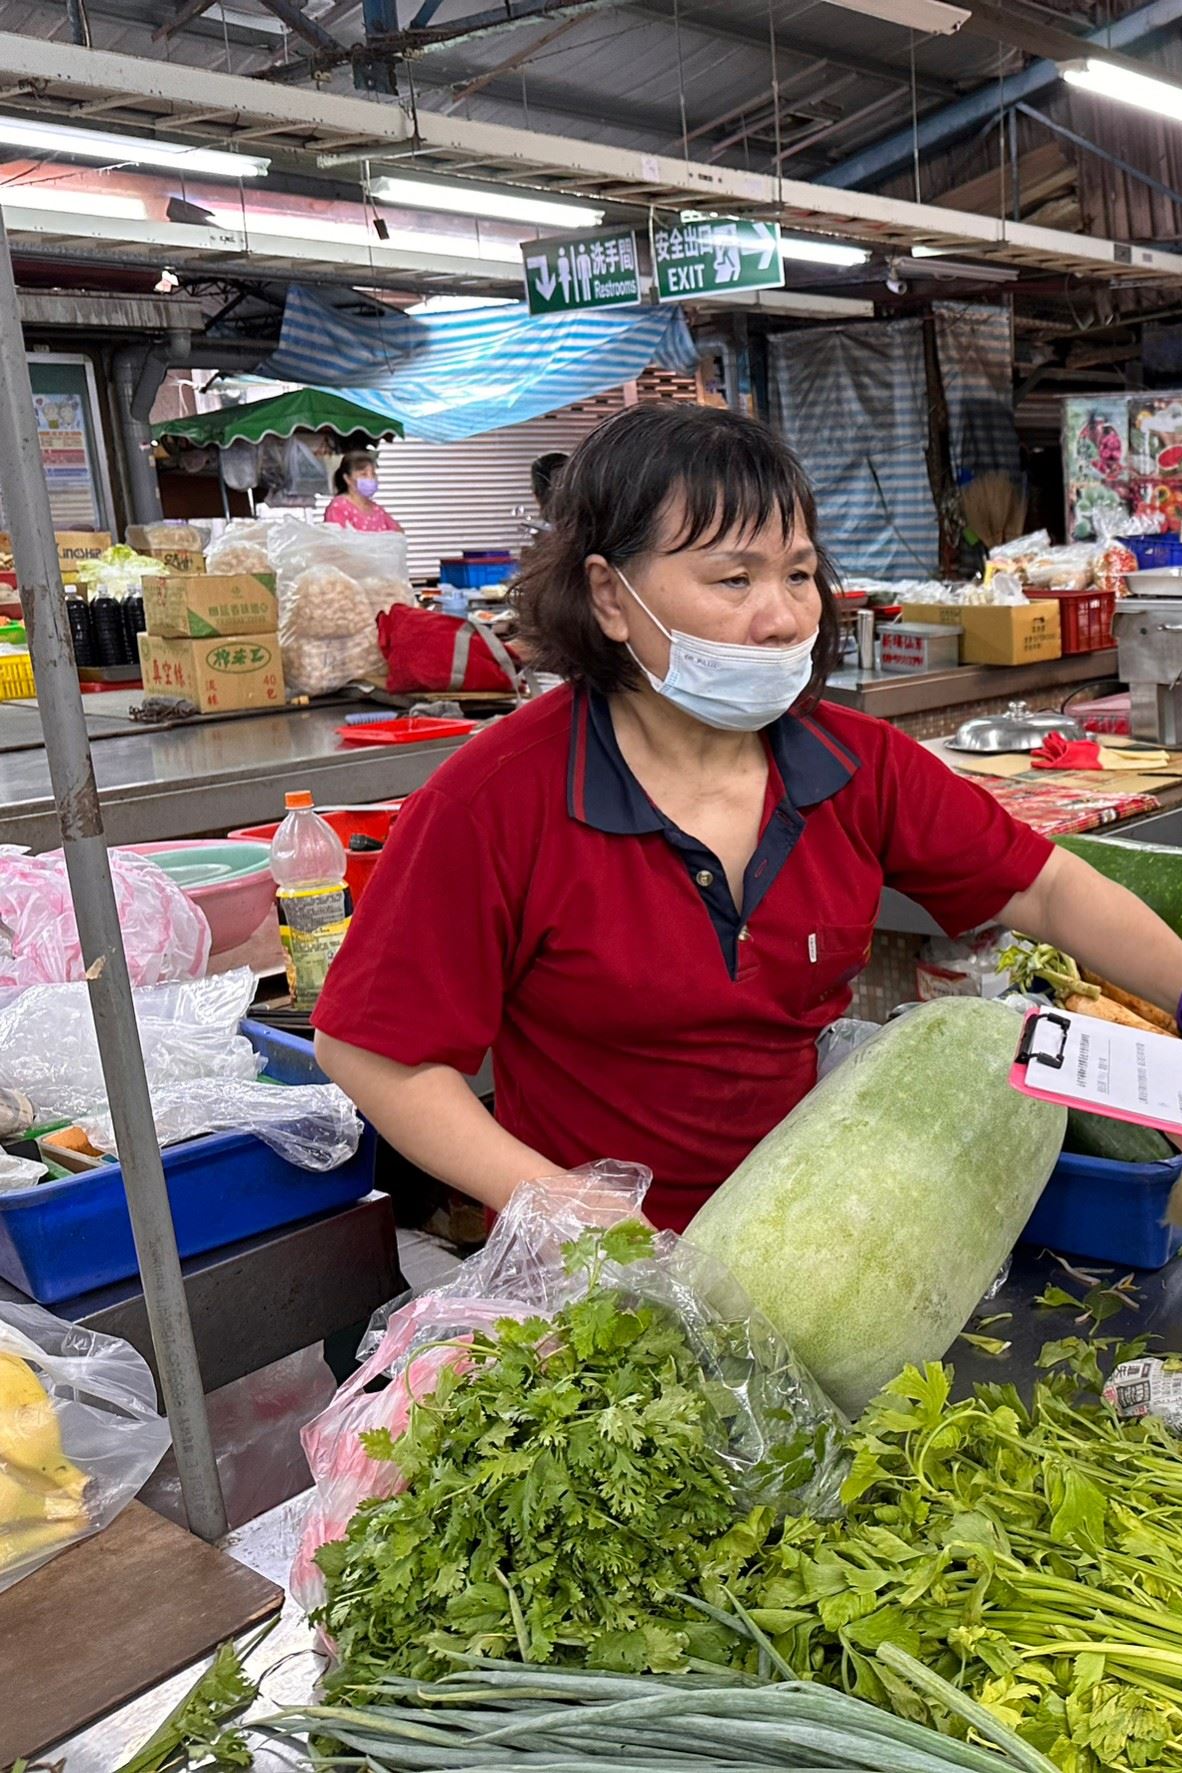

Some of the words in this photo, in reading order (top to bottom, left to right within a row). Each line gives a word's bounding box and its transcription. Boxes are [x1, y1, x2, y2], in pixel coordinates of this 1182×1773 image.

[590, 237, 634, 276] 洗手間
[655, 225, 713, 262] 安全出口
[594, 279, 637, 300] Restrooms
[668, 264, 705, 292] EXIT
